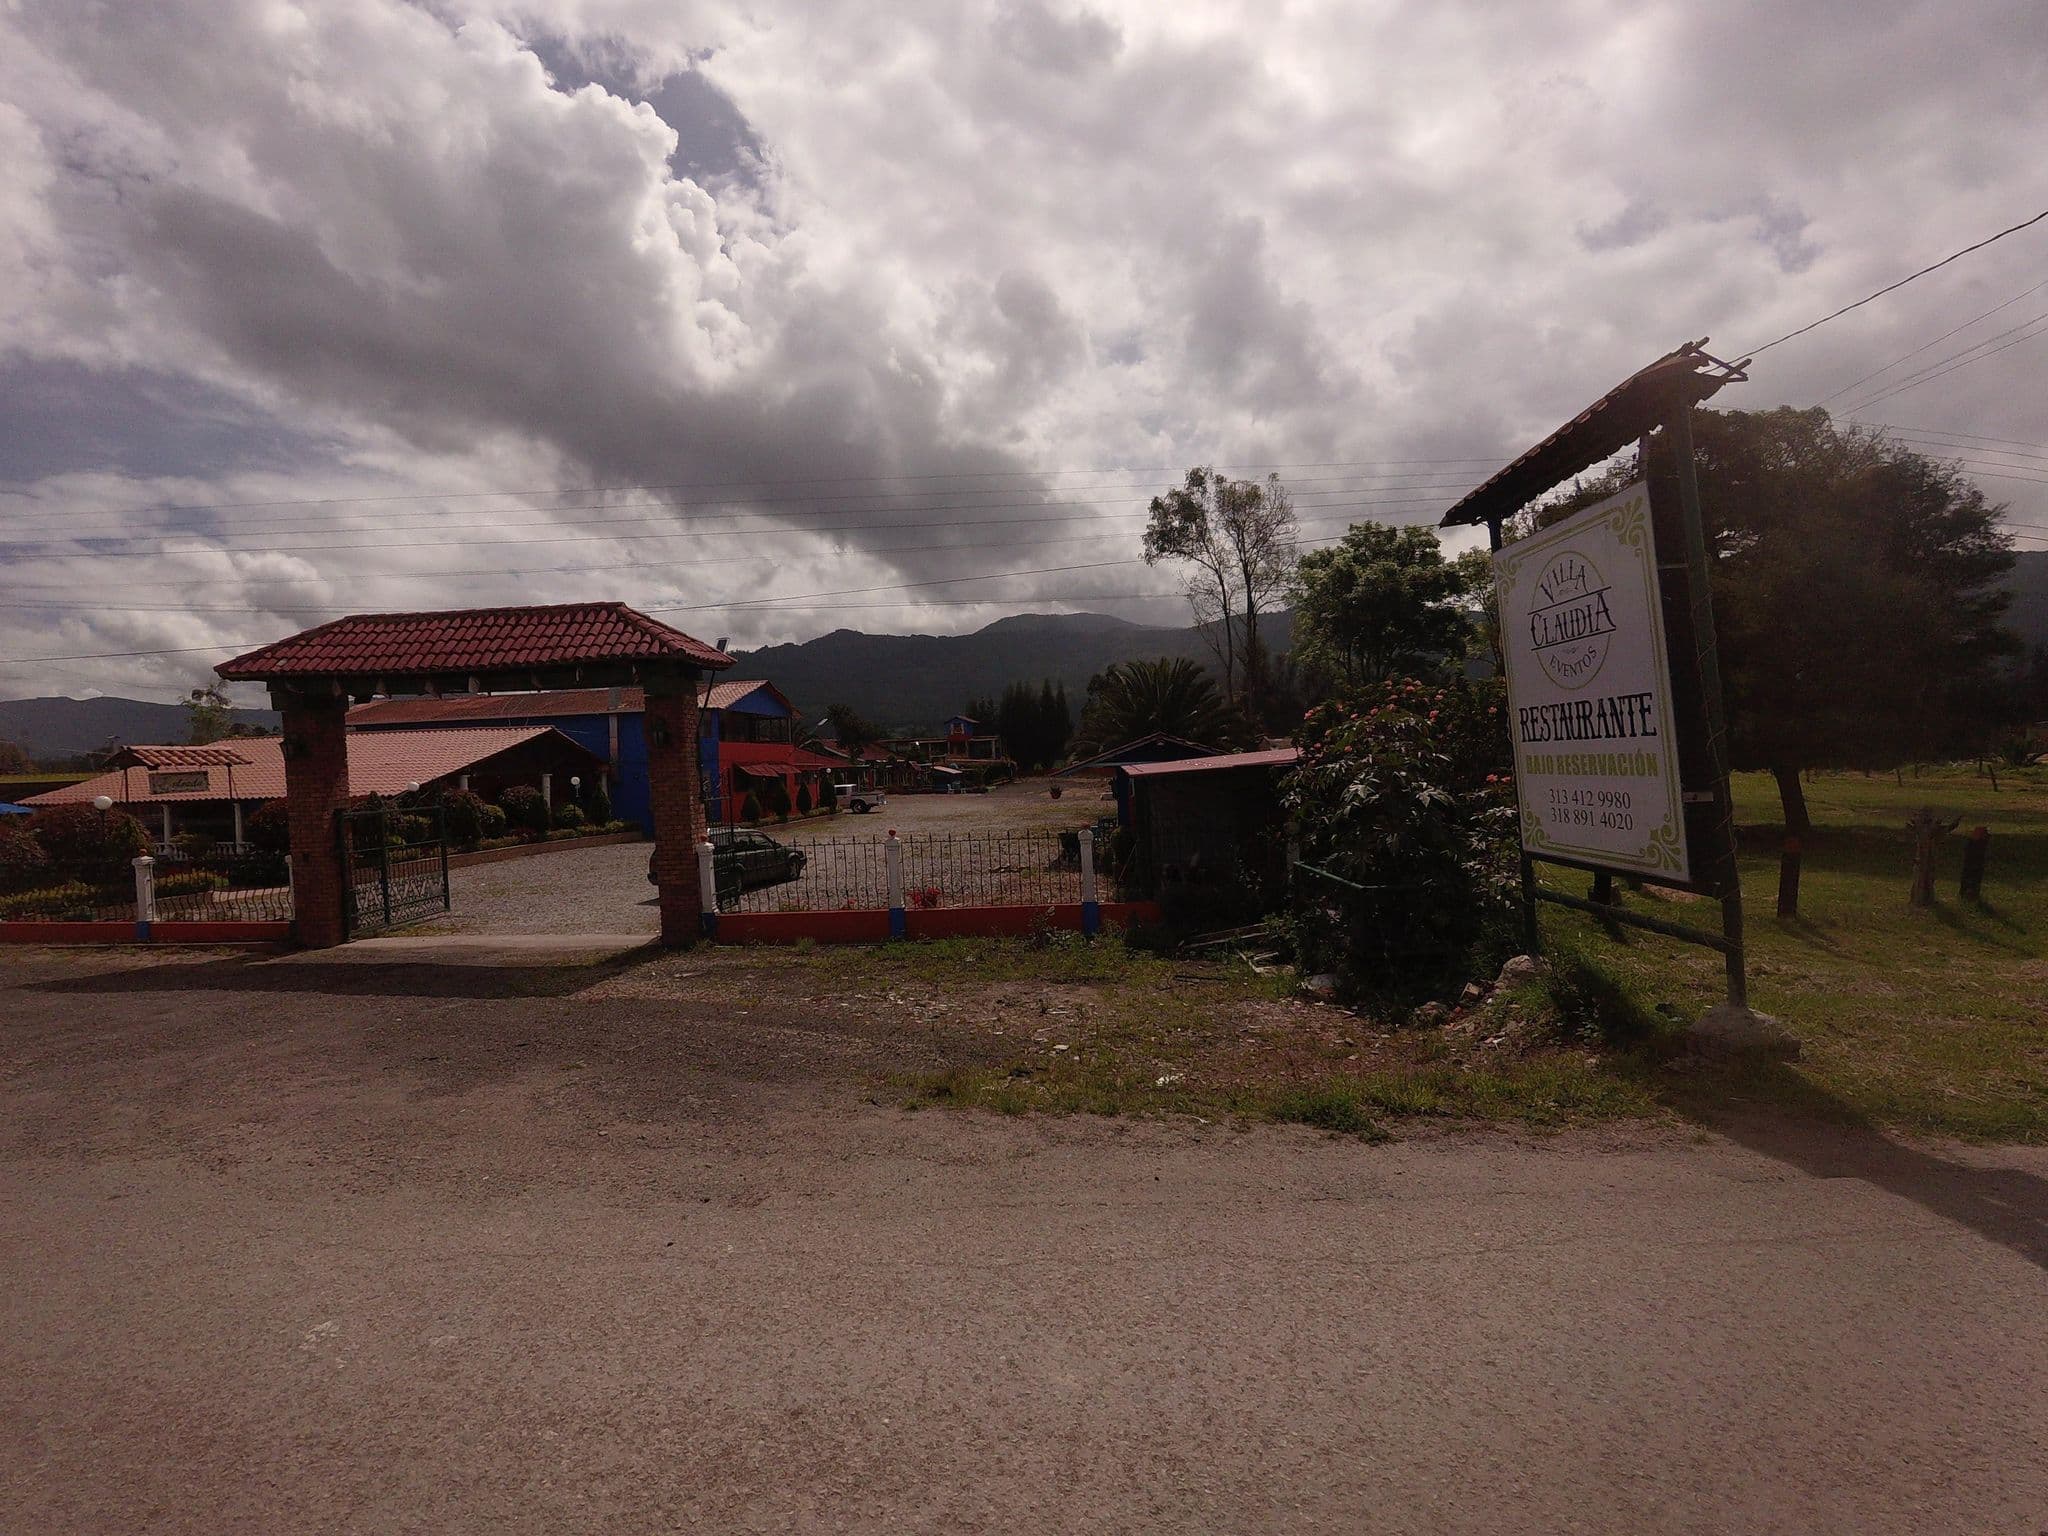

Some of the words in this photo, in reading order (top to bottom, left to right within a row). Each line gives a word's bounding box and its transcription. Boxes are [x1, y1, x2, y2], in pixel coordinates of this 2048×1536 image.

[1540, 559, 1590, 604] VILLA
[1530, 591, 1617, 647] CLAUDIA
[1549, 646, 1598, 678] EVENTOS
[1518, 691, 1657, 743] RESTAURANTE
[1525, 754, 1554, 775] BAJO
[1556, 749, 1659, 777] RESERVACIÓN
[1549, 789, 1569, 805] 313
[1572, 789, 1594, 807] 412
[1597, 791, 1631, 810] 9980
[1551, 807, 1571, 824] 318
[1573, 810, 1595, 827] 891
[1600, 812, 1633, 831] 4020
